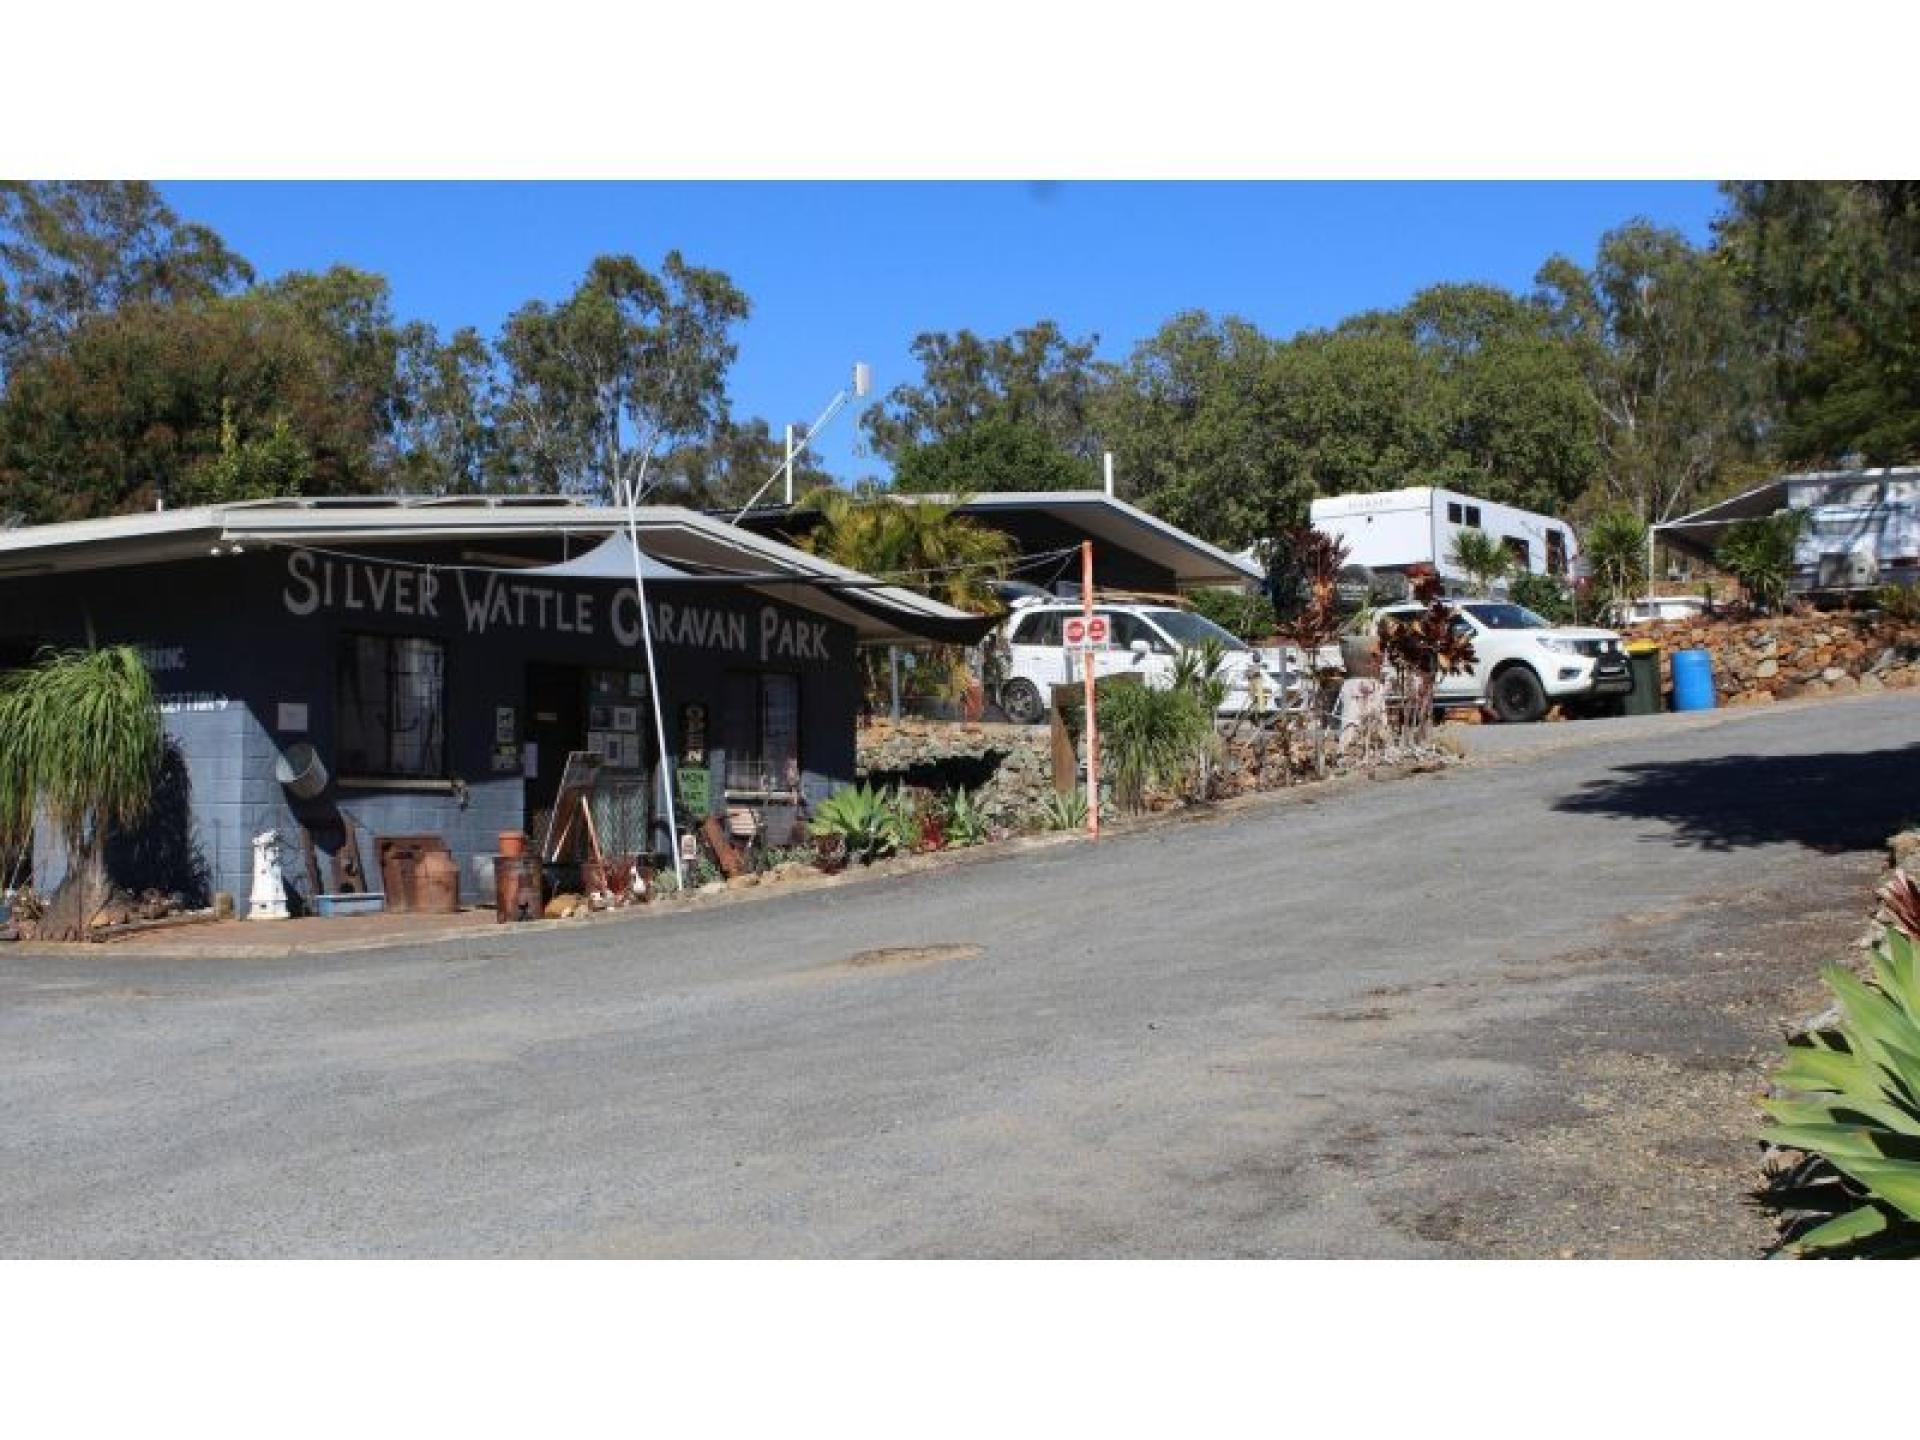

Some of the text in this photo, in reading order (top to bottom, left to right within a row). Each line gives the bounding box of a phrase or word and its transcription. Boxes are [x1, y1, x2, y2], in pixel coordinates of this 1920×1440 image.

[284, 551, 440, 616] SILVER
[456, 568, 594, 634] WATTLE
[760, 607, 829, 661] PARK
